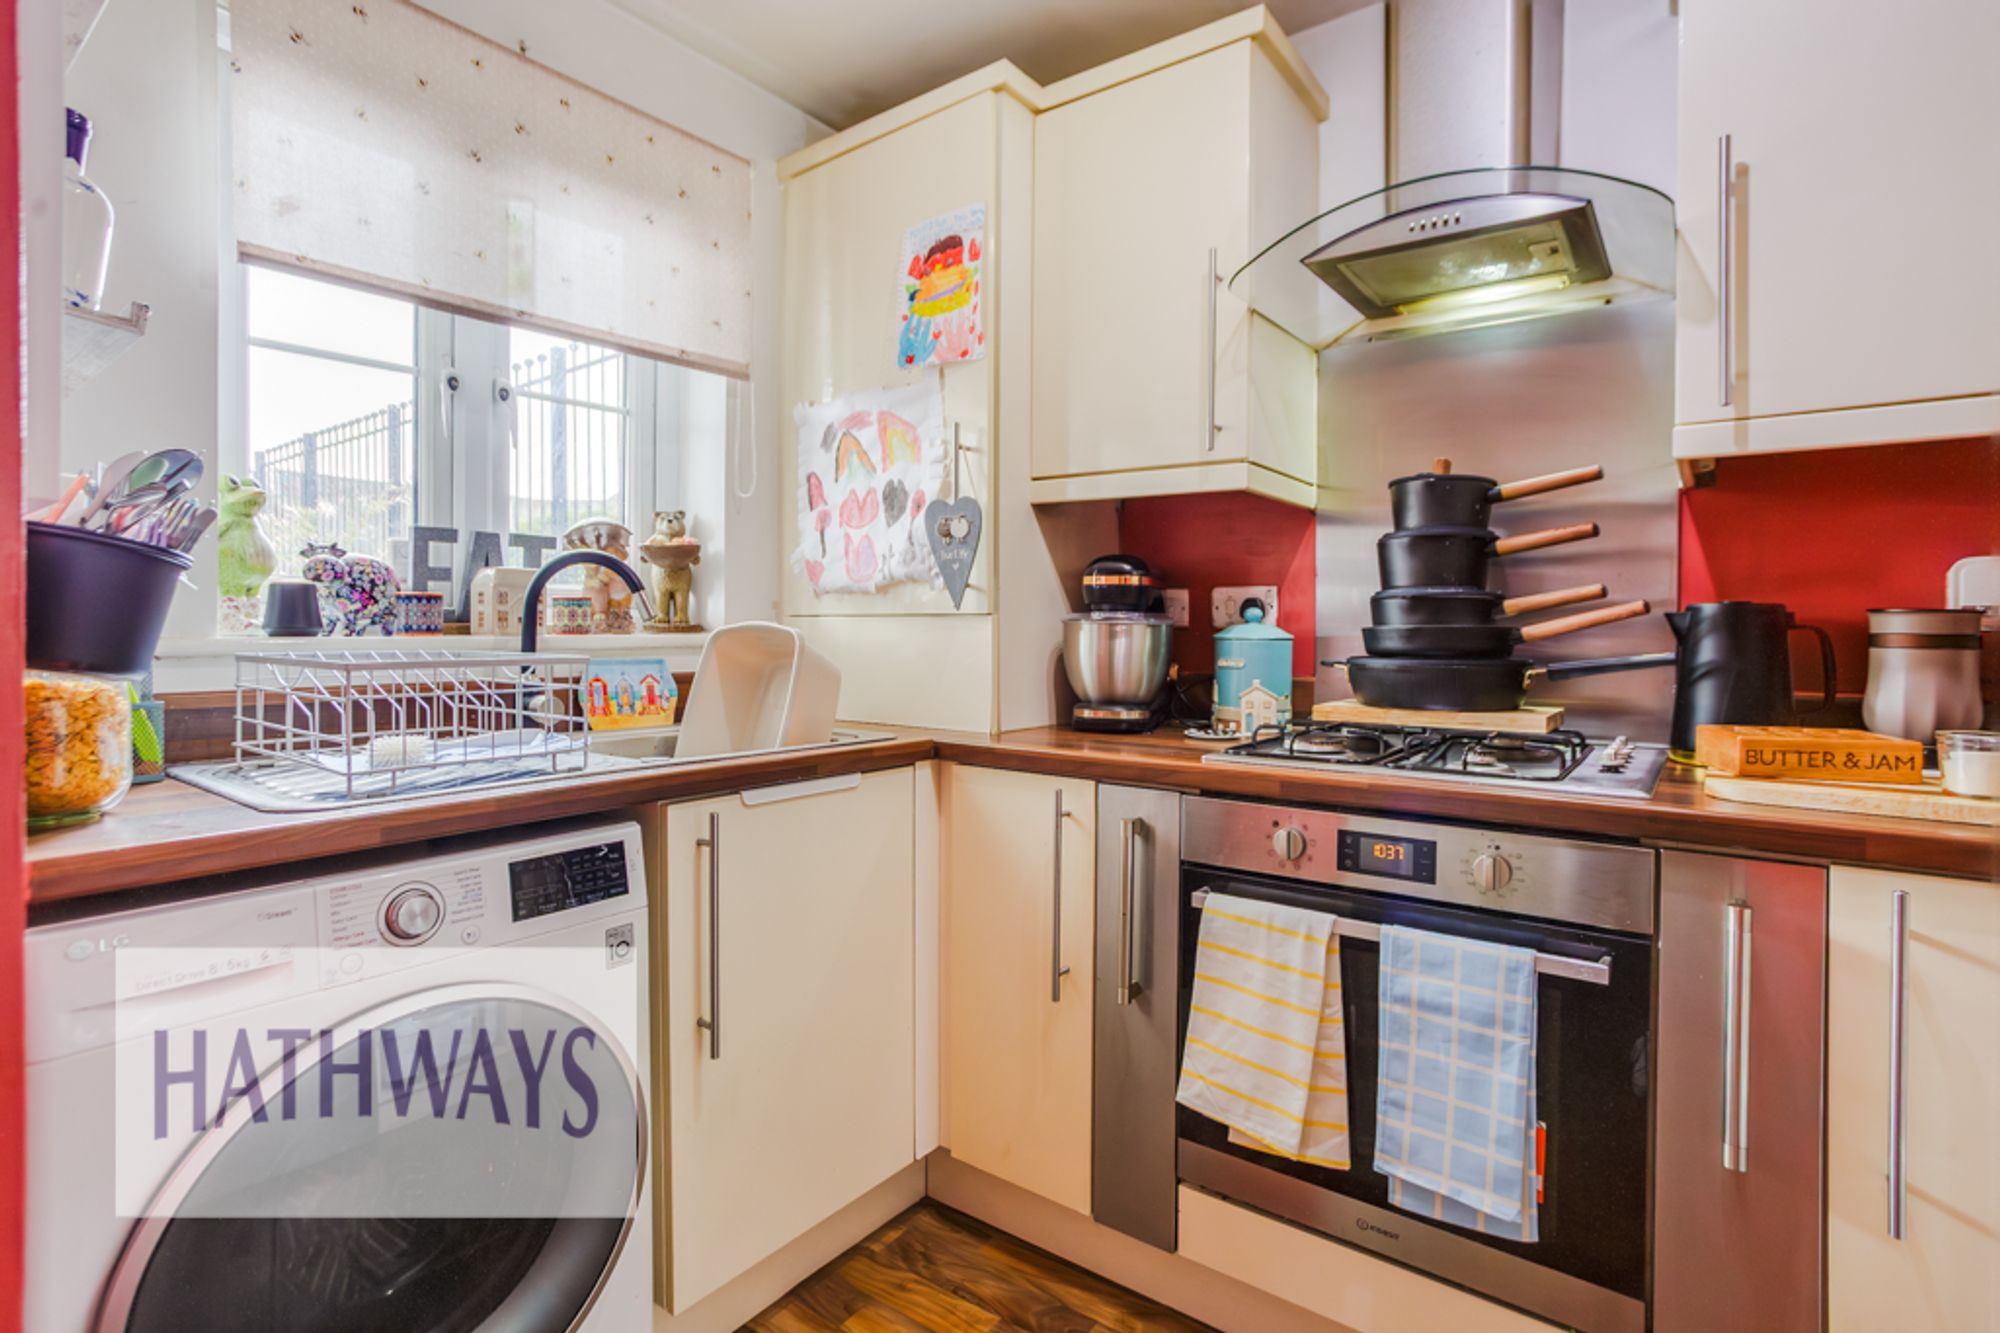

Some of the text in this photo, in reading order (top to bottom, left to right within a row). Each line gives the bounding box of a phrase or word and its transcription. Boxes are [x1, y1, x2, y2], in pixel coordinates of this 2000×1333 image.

[412, 526, 557, 623] EAT
[1745, 749, 1916, 771] BUTTER & JAM
[99, 934, 129, 952] LG
